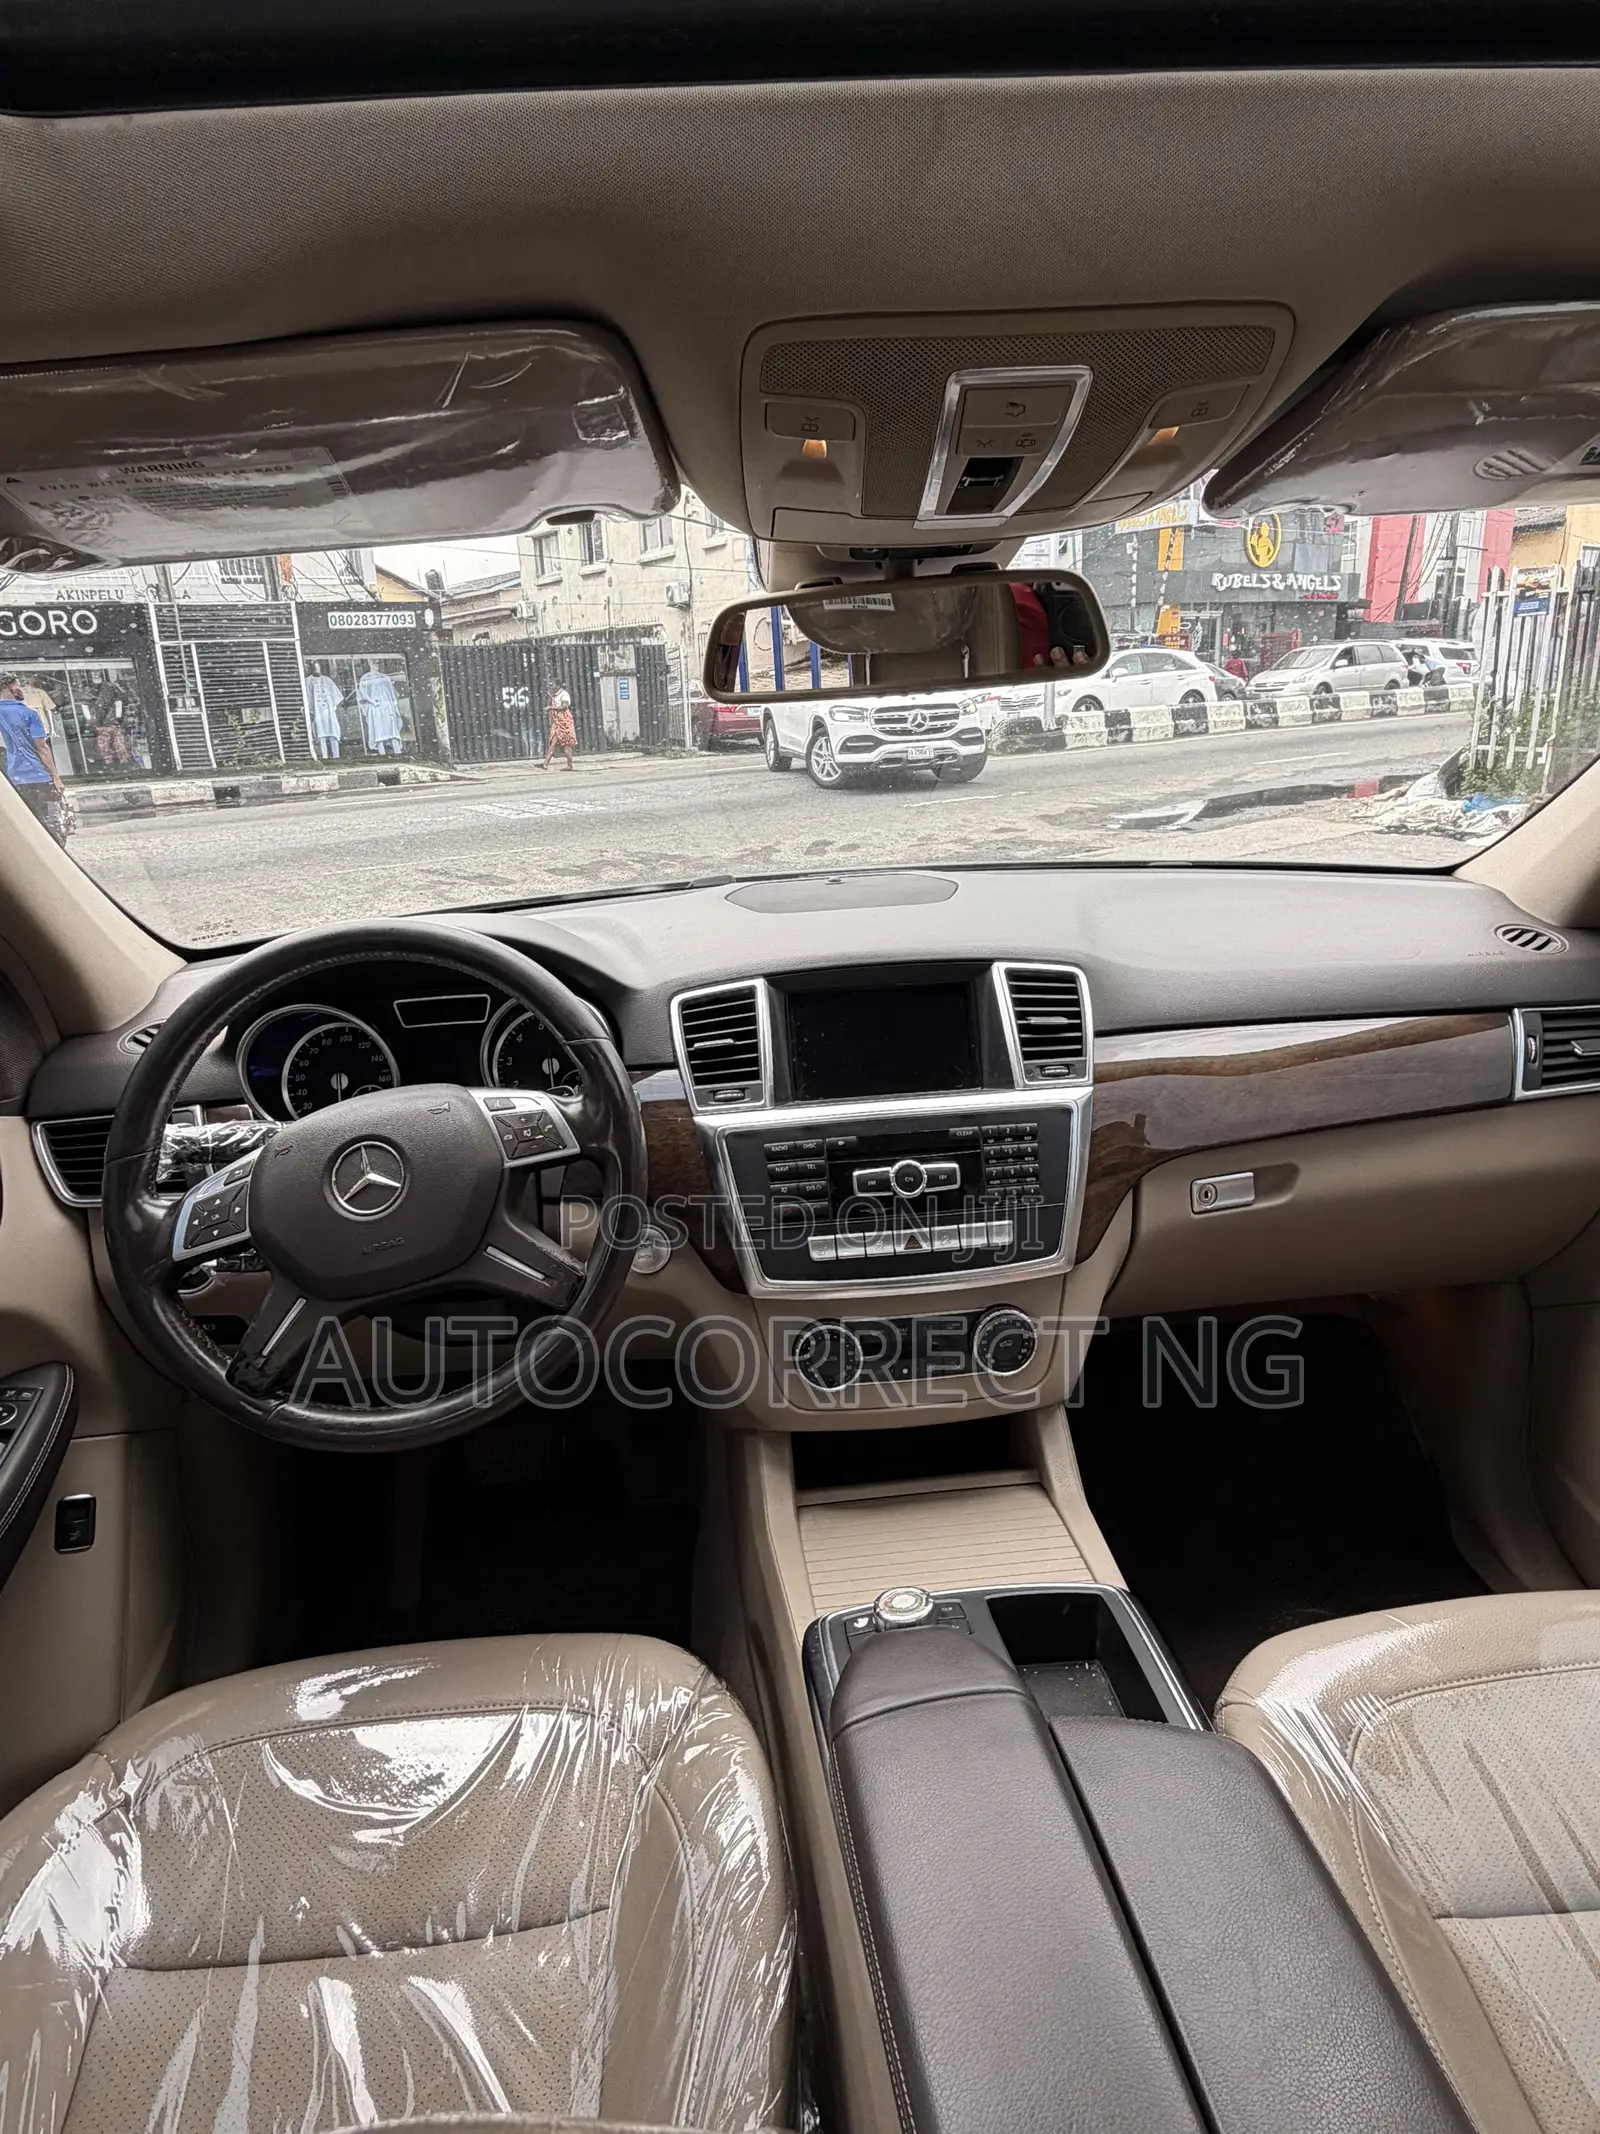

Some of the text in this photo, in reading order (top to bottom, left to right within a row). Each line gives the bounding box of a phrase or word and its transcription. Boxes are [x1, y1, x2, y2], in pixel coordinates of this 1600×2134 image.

[118, 460, 206, 475] WARNING
[87, 479, 127, 488] WITH
[56, 589, 124, 600] AKINPELU
[329, 613, 415, 626] 08028377093
[340, 1034, 353, 1043] 100
[358, 1041, 371, 1049] 120
[309, 1047, 319, 1055] 70
[371, 1054, 384, 1062] 140
[506, 1056, 513, 1066] 3
[295, 1074, 306, 1082] 50
[378, 1074, 391, 1083] 160
[296, 1088, 308, 1096] 40
[302, 1102, 313, 1110] 30
